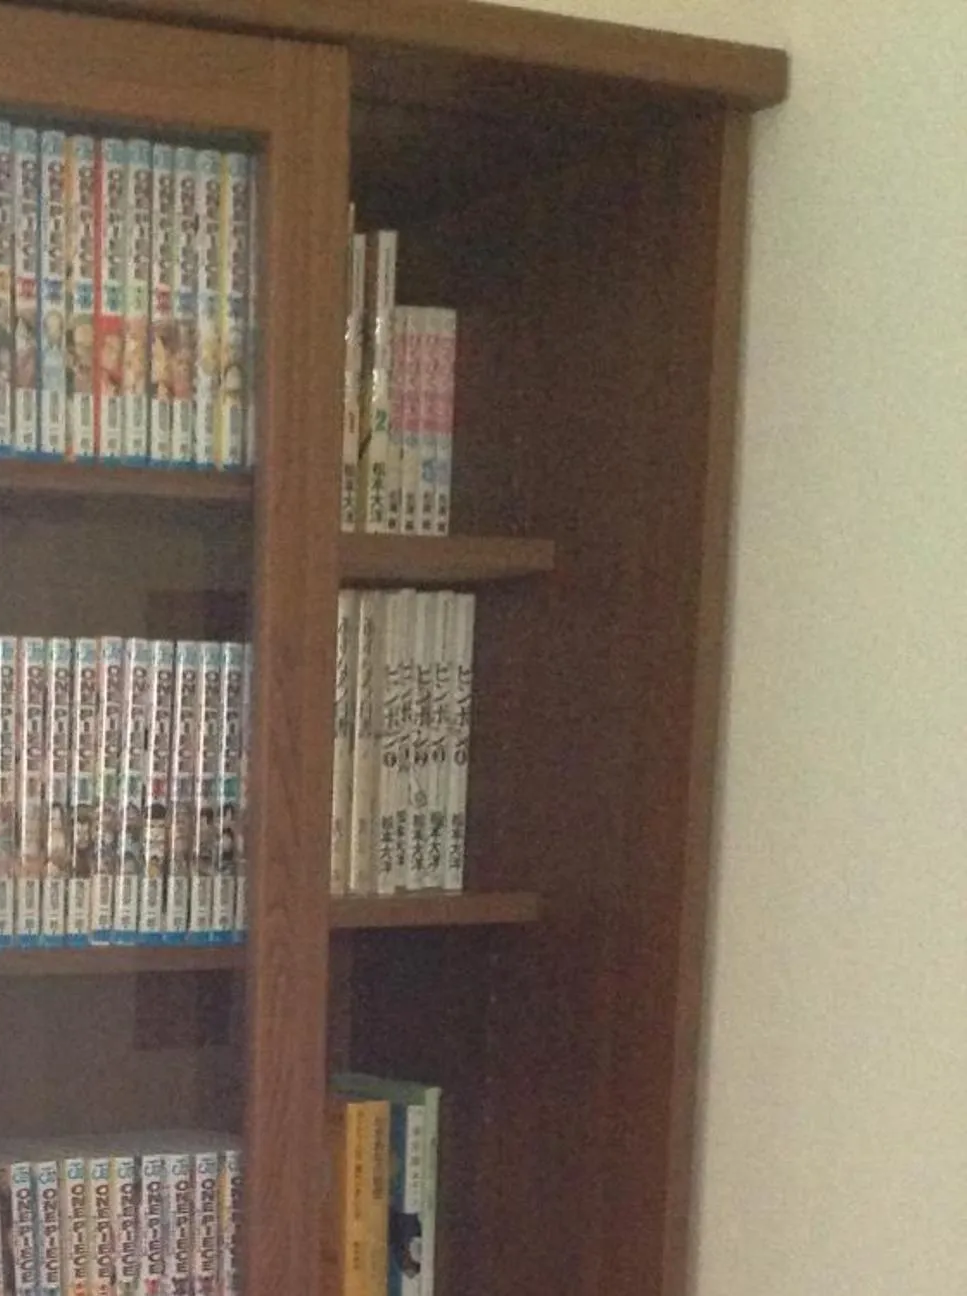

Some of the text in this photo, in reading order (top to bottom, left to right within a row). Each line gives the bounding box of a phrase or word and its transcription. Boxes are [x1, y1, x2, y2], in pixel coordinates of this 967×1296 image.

[17, 1187, 33, 1284] ONE PIECE
[43, 1187, 59, 1283] ONE PIECE
[71, 1183, 87, 1279] ONE PIECE
[96, 1183, 111, 1279] ONE PIECE
[120, 1181, 137, 1277] ONE PIECE
[146, 1180, 162, 1275] ONE PIECE
[175, 1180, 190, 1274] ONE PIECE
[201, 1178, 217, 1272] ONE PIECE
